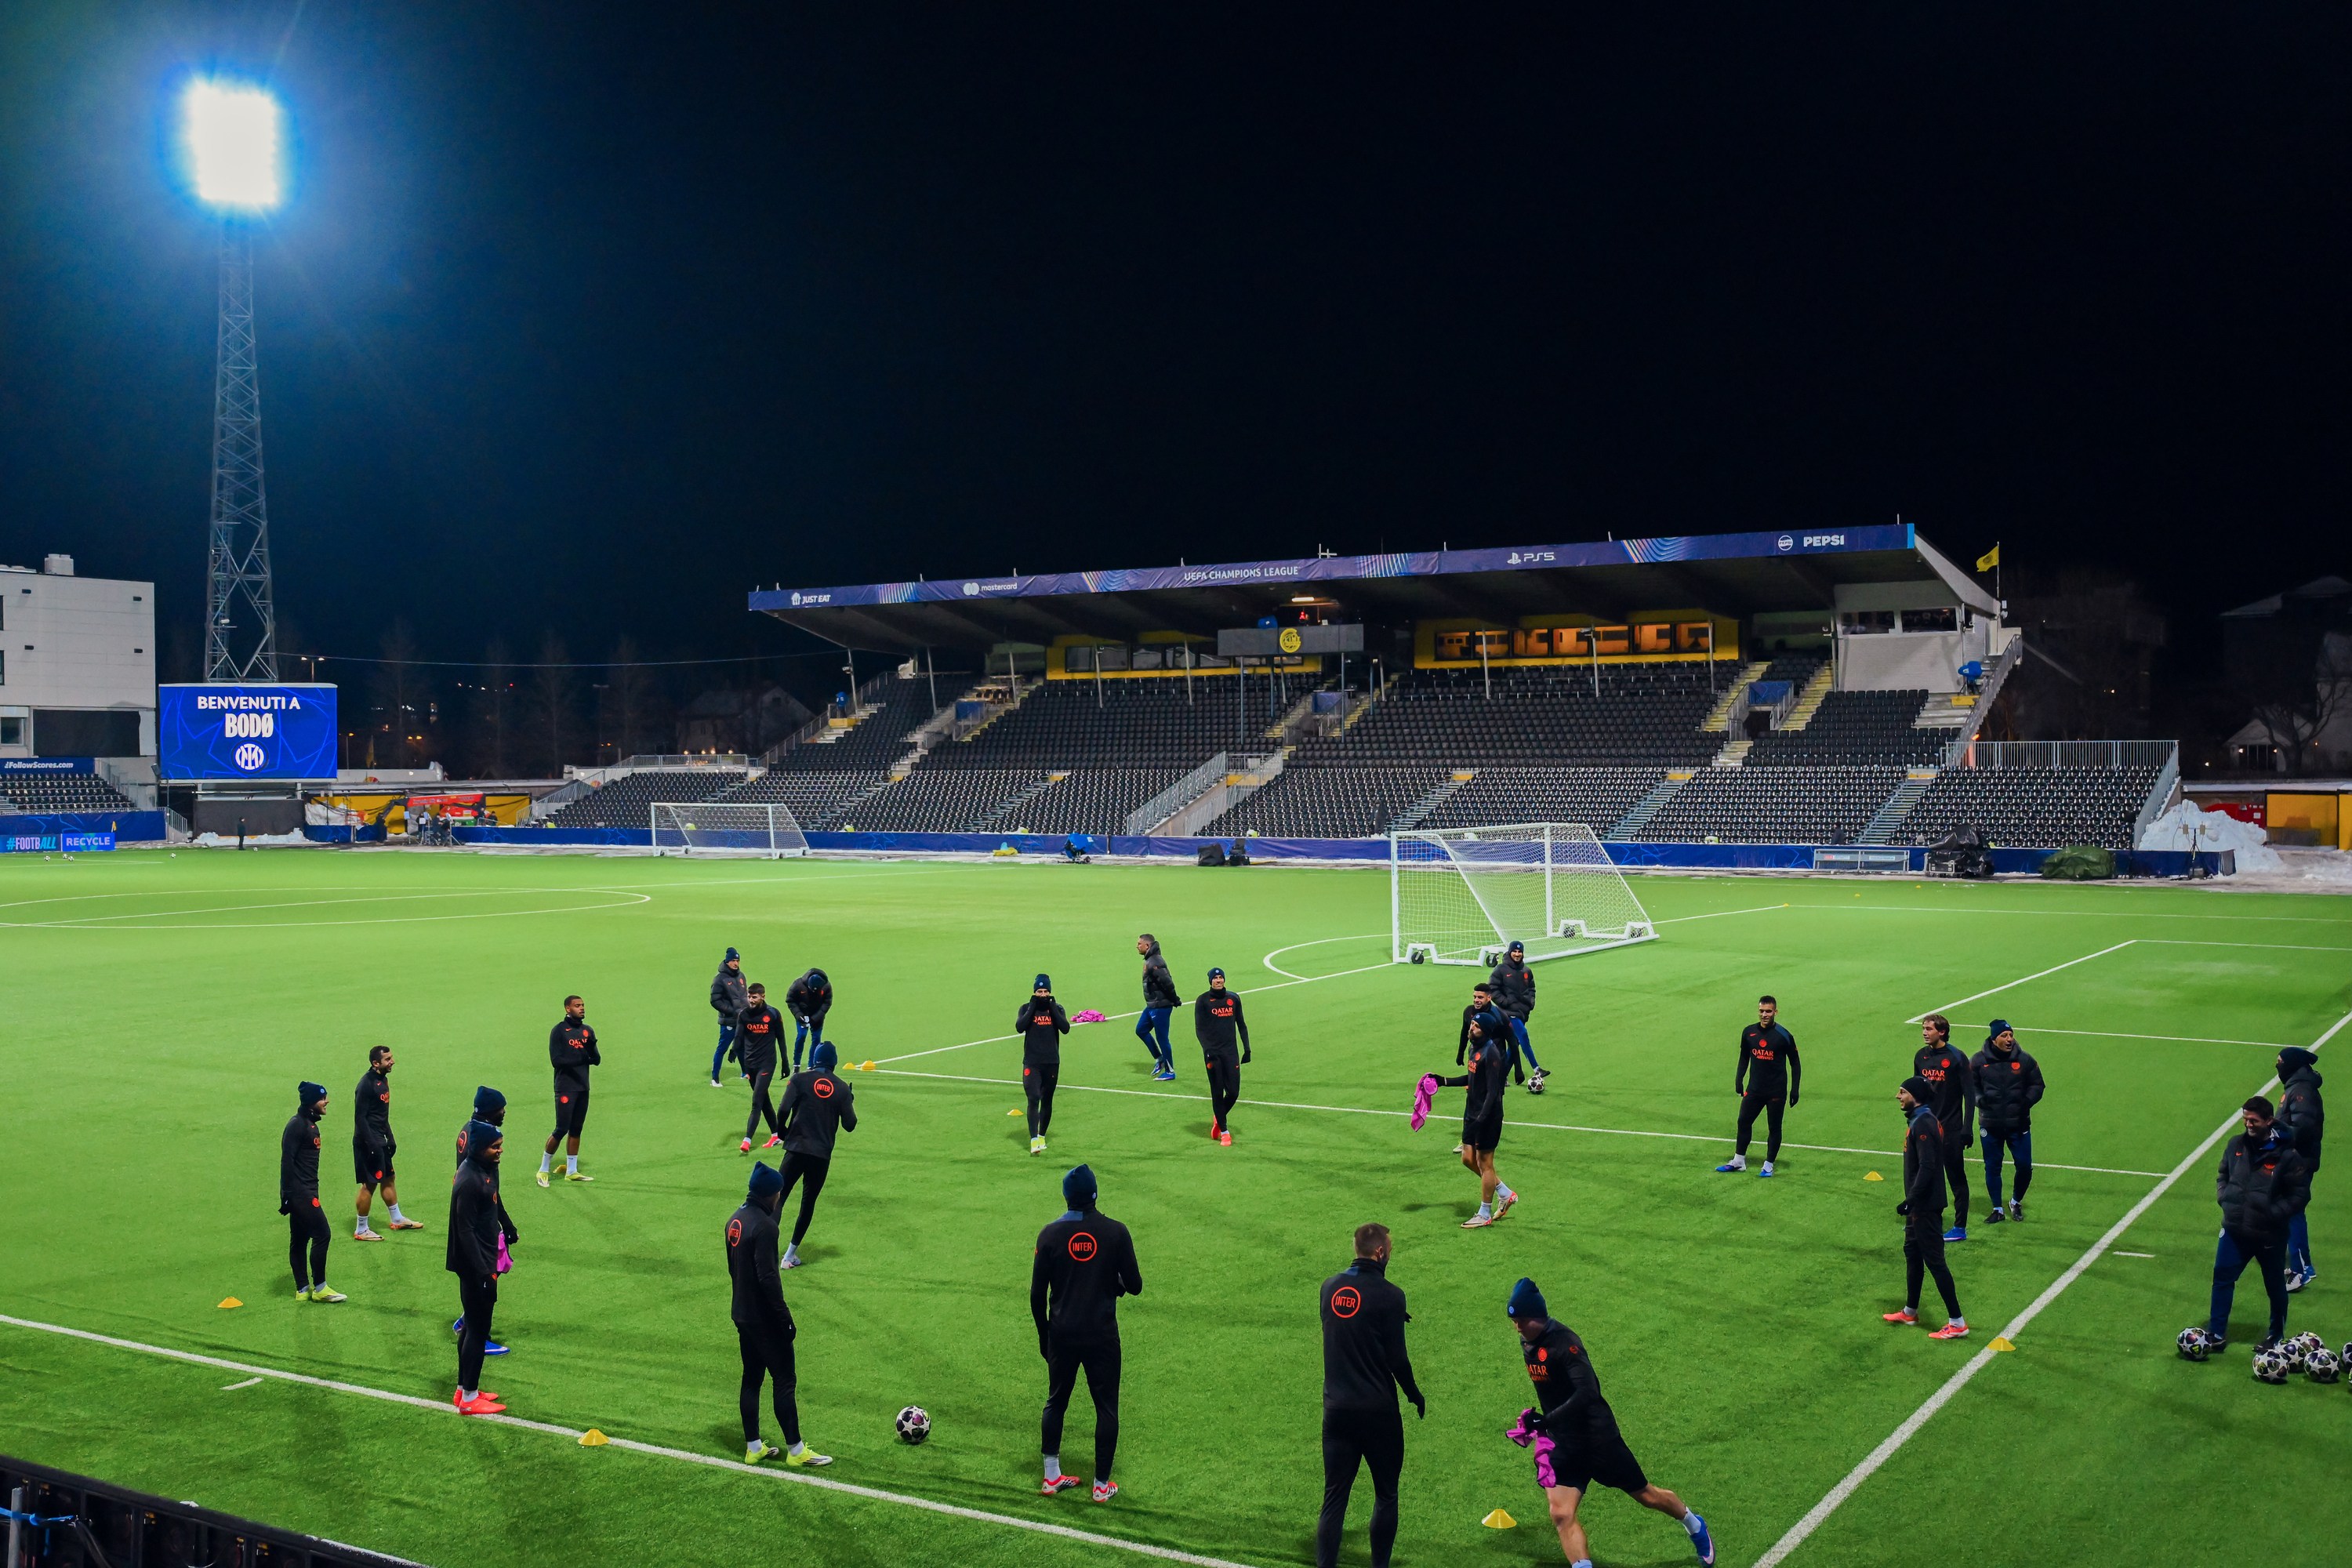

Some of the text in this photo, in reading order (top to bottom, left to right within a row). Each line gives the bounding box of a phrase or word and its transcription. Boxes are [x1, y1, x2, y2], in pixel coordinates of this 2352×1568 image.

[1803, 535, 1845, 547] PEPSI
[1523, 552, 1555, 562] PS5
[1184, 566, 1298, 581] UEFA CHAMPIONS LEAGUE
[981, 583, 1018, 591] mastercard
[801, 594, 831, 604] JUST EAT
[198, 696, 300, 710] BENVENUTI A
[225, 713, 274, 738] BODØ
[6, 837, 56, 850] #FOOTBALL
[66, 837, 110, 846] RECYCLE
[1211, 1007, 1233, 1015] QATAR
[1751, 1047, 1774, 1057] QATAR
[1922, 1069, 1944, 1077] QATAR
[816, 1083, 831, 1093] INTER
[1073, 1242, 1092, 1252] INTER
[1335, 1296, 1356, 1308] INTER
